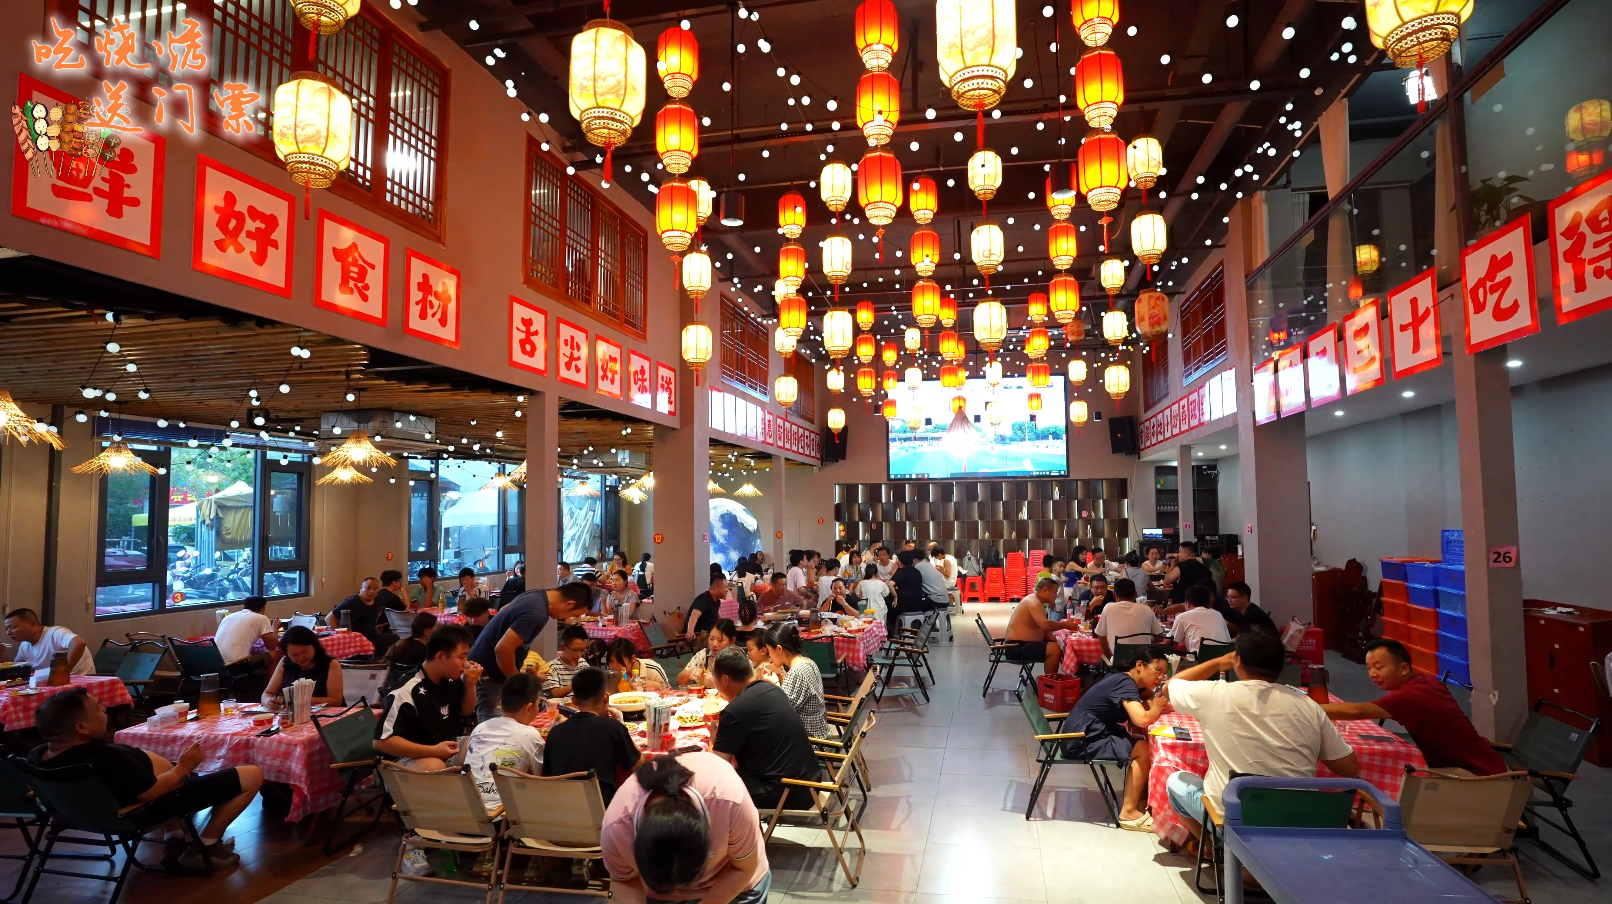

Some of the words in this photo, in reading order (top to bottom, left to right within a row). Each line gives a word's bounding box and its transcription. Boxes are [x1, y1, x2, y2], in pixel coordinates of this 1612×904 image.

[515, 317, 674, 405] 舌尖好味道
[654, 534, 662, 543] 12
[1492, 551, 1513, 564] 26
[174, 592, 182, 603] 3
